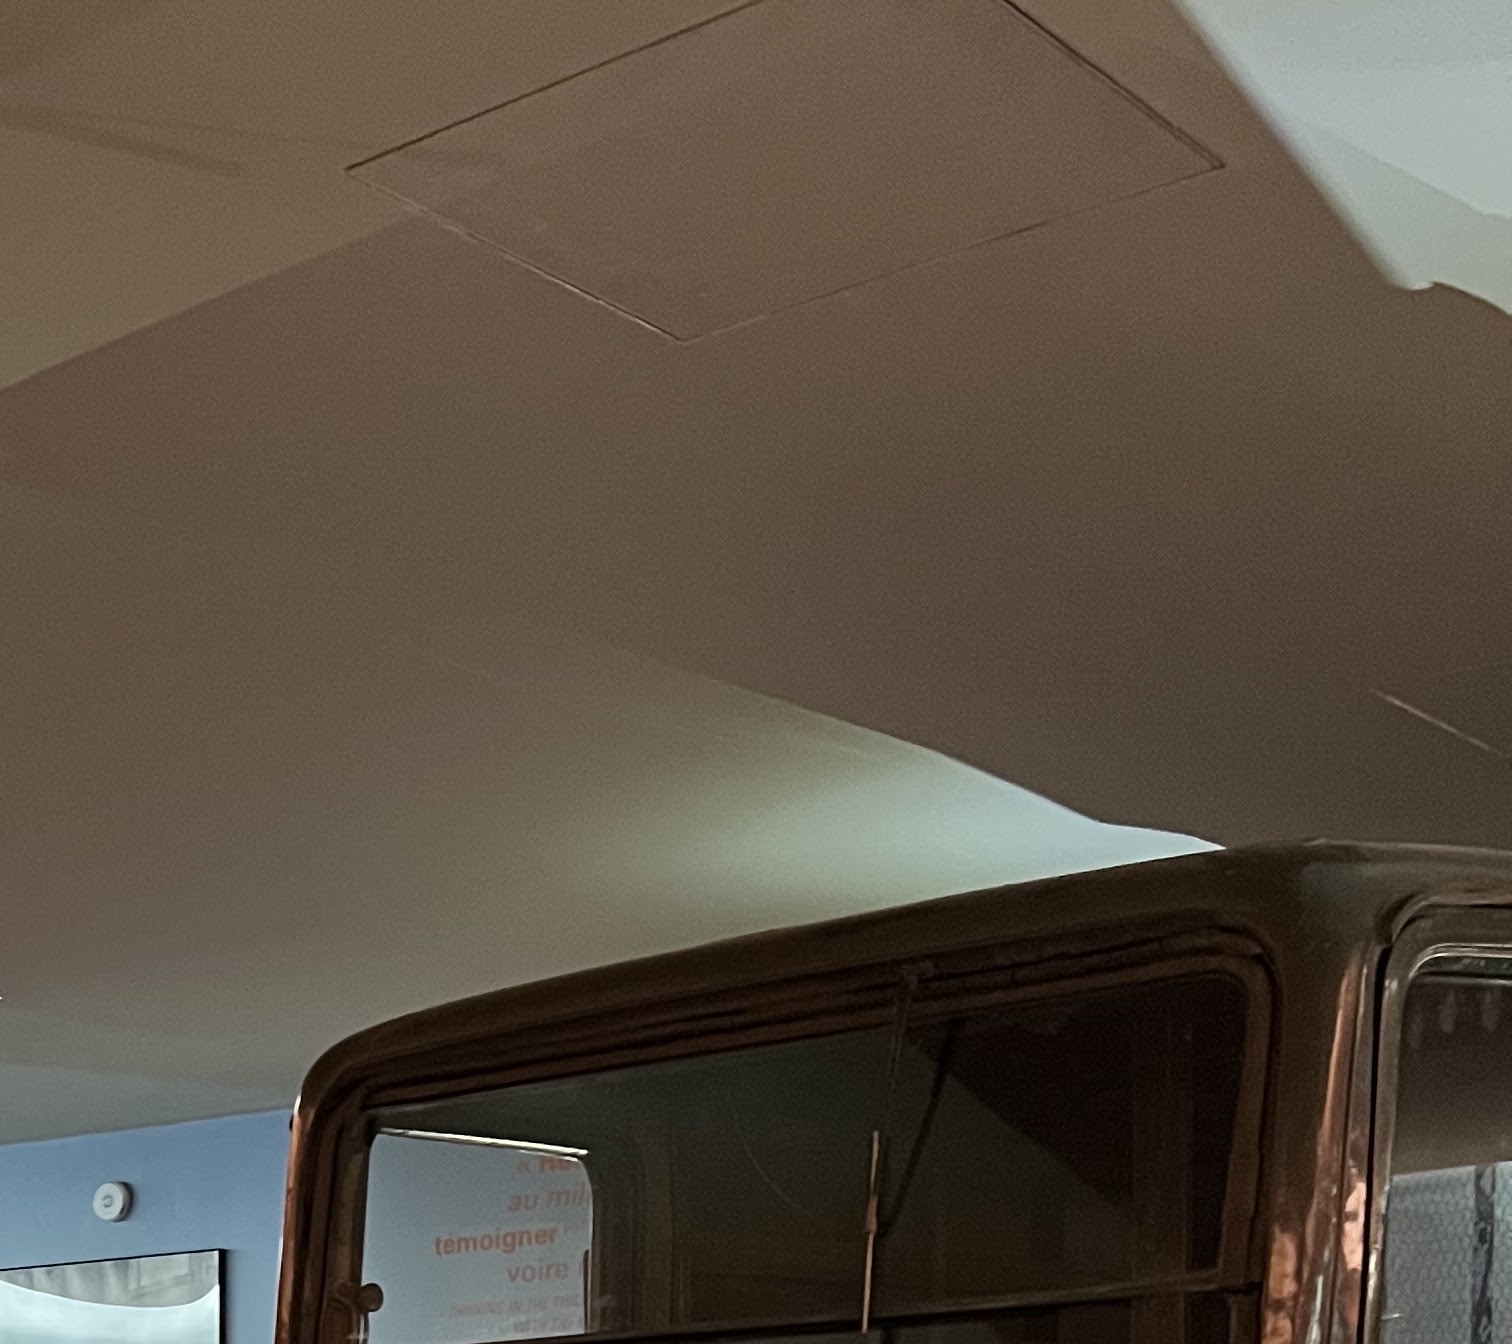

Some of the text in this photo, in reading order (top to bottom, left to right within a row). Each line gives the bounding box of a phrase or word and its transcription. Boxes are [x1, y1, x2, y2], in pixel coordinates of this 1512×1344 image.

[507, 1193, 538, 1212] au
[434, 1225, 559, 1257] témoigner
[506, 1258, 569, 1283] voire
